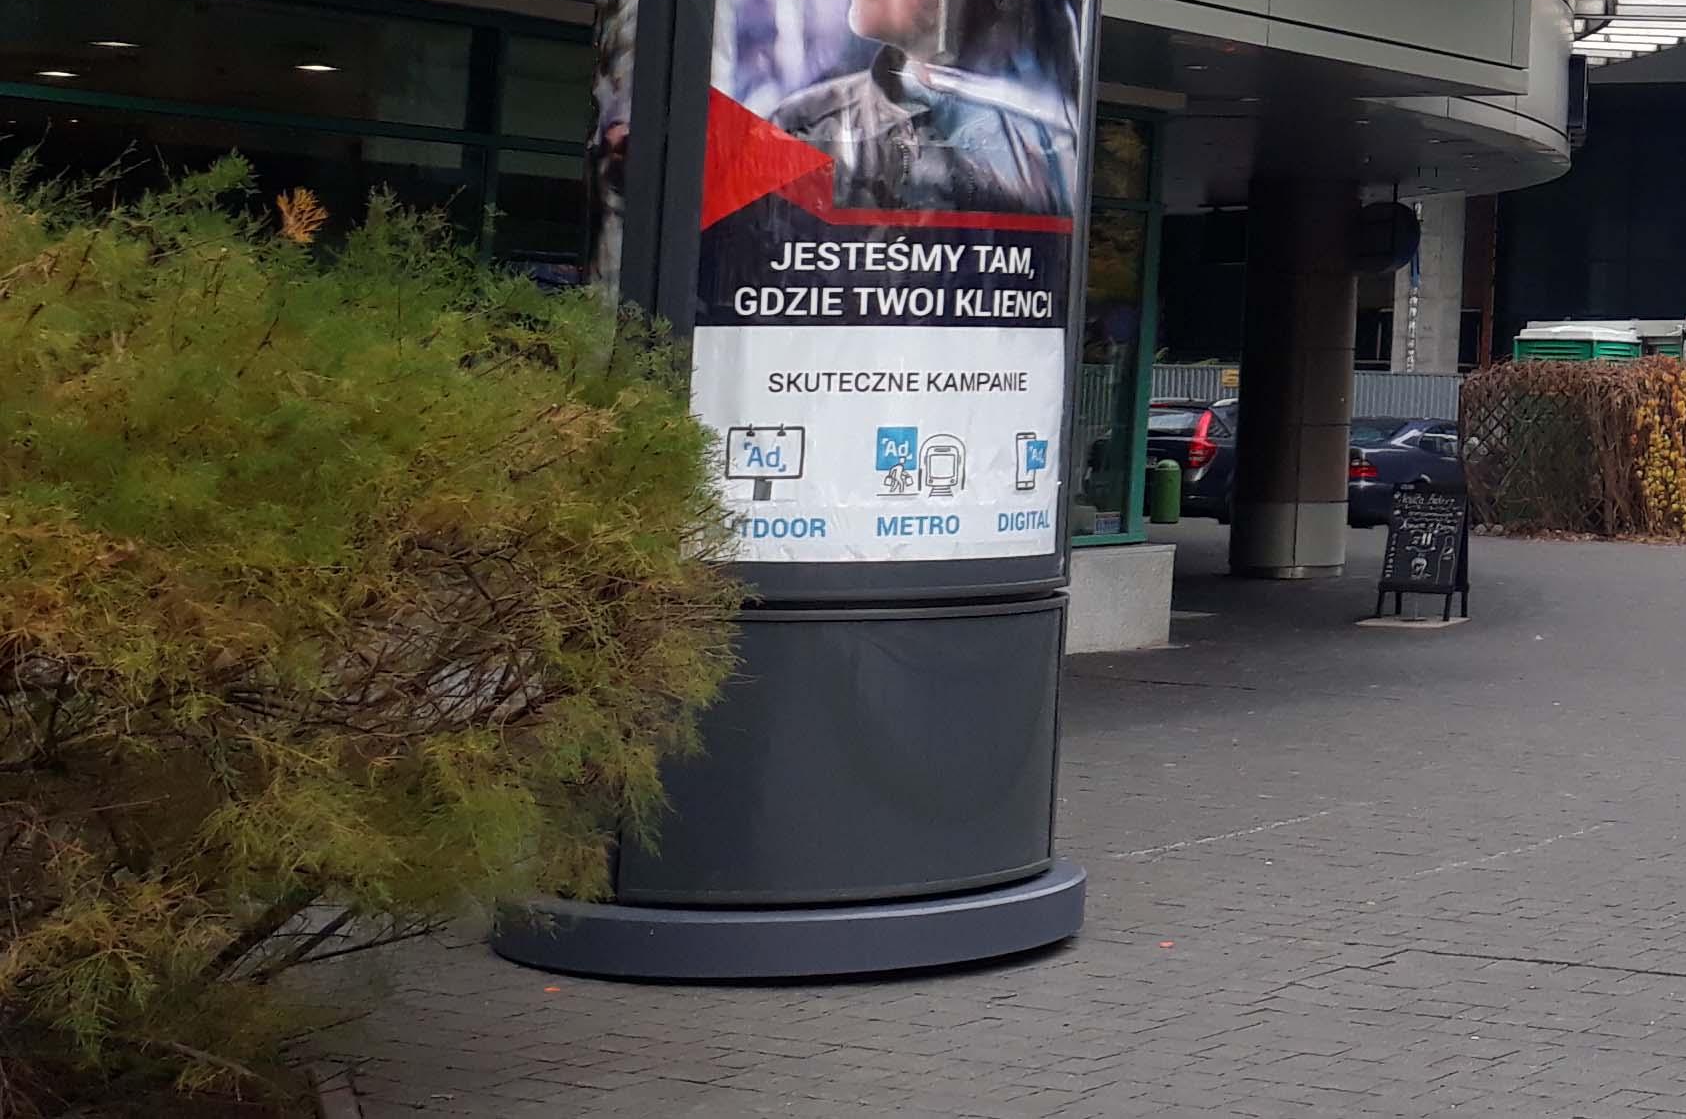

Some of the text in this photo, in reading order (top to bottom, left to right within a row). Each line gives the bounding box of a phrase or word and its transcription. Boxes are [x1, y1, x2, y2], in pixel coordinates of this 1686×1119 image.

[770, 235, 1035, 280] JESTEŚMY TAM,
[733, 286, 1053, 319] GDZIE TWOI KLIENCI
[767, 371, 1029, 393] SKUTECZNE KAMPANIE
[728, 517, 827, 539] TDOOR
[876, 515, 961, 537] METRO
[998, 510, 1051, 533] DIGITAL
